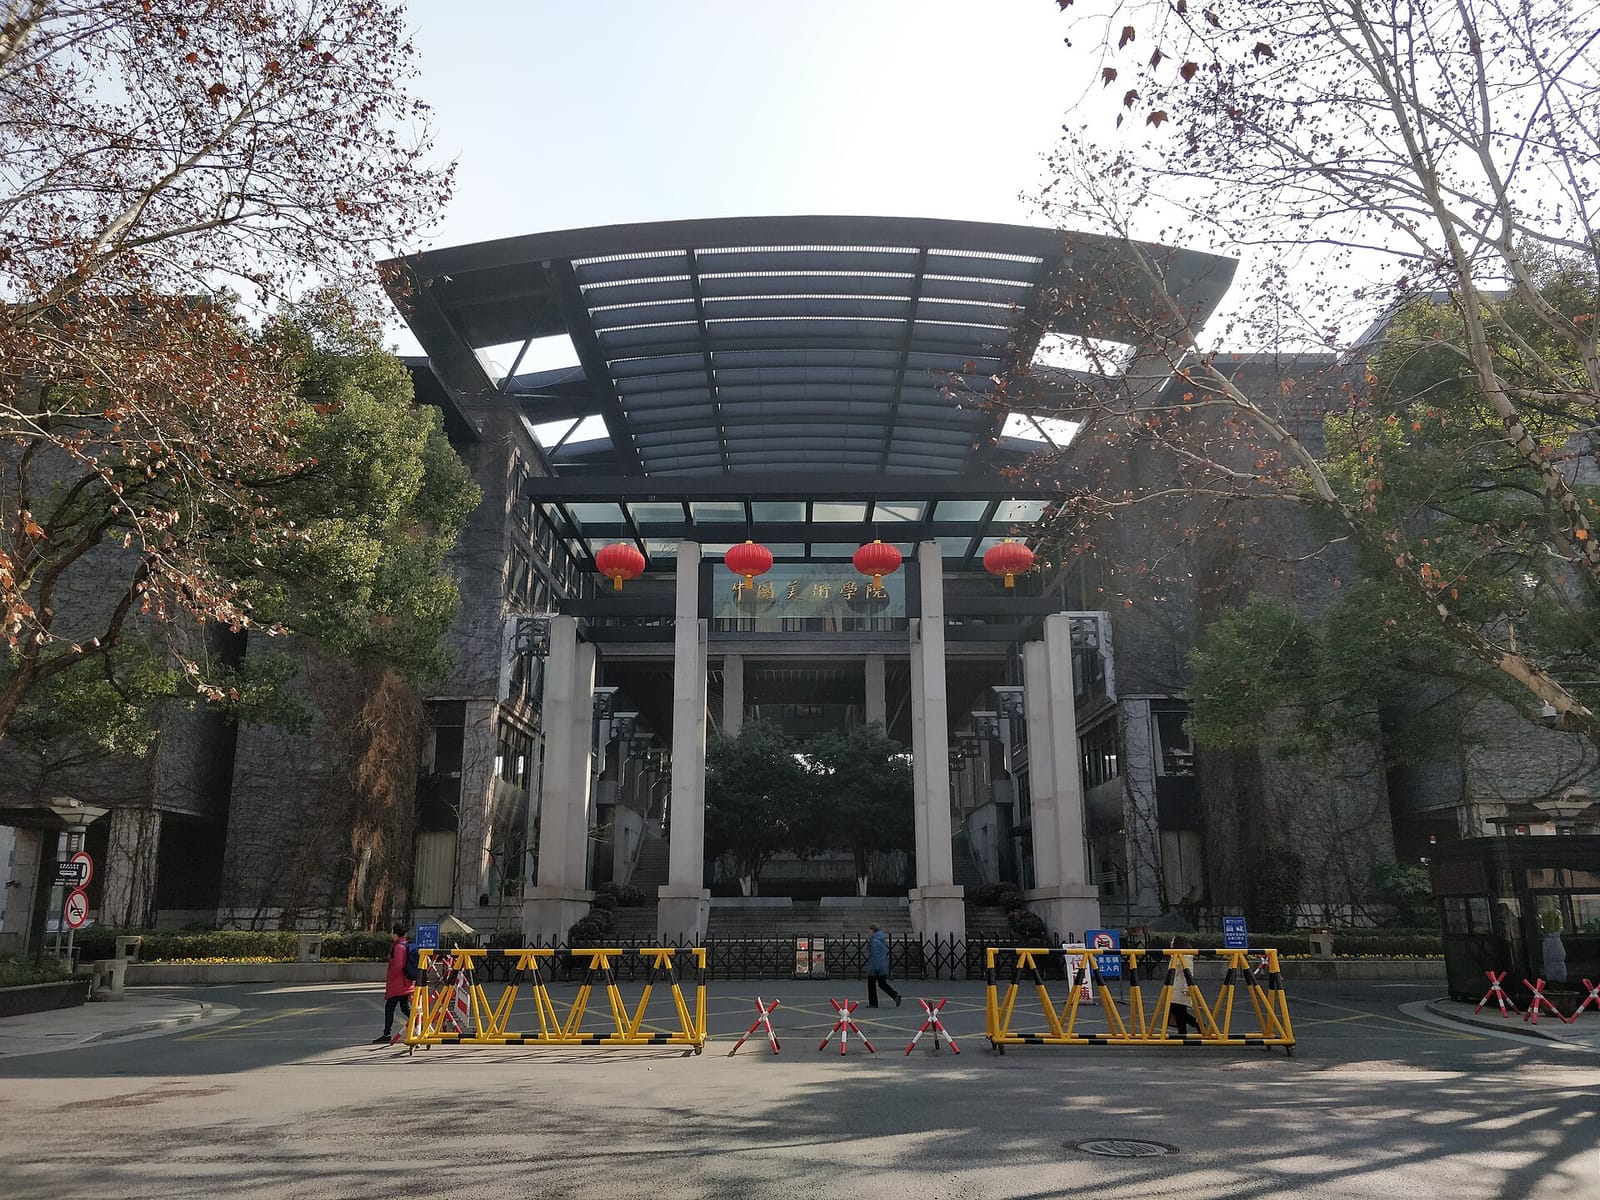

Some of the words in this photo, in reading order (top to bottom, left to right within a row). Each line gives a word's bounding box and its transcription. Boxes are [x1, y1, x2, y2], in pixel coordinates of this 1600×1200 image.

[732, 580, 889, 602] 中國美術學院
[1095, 956, 1119, 964] 来车辆
[1097, 965, 1120, 973] 止入内
